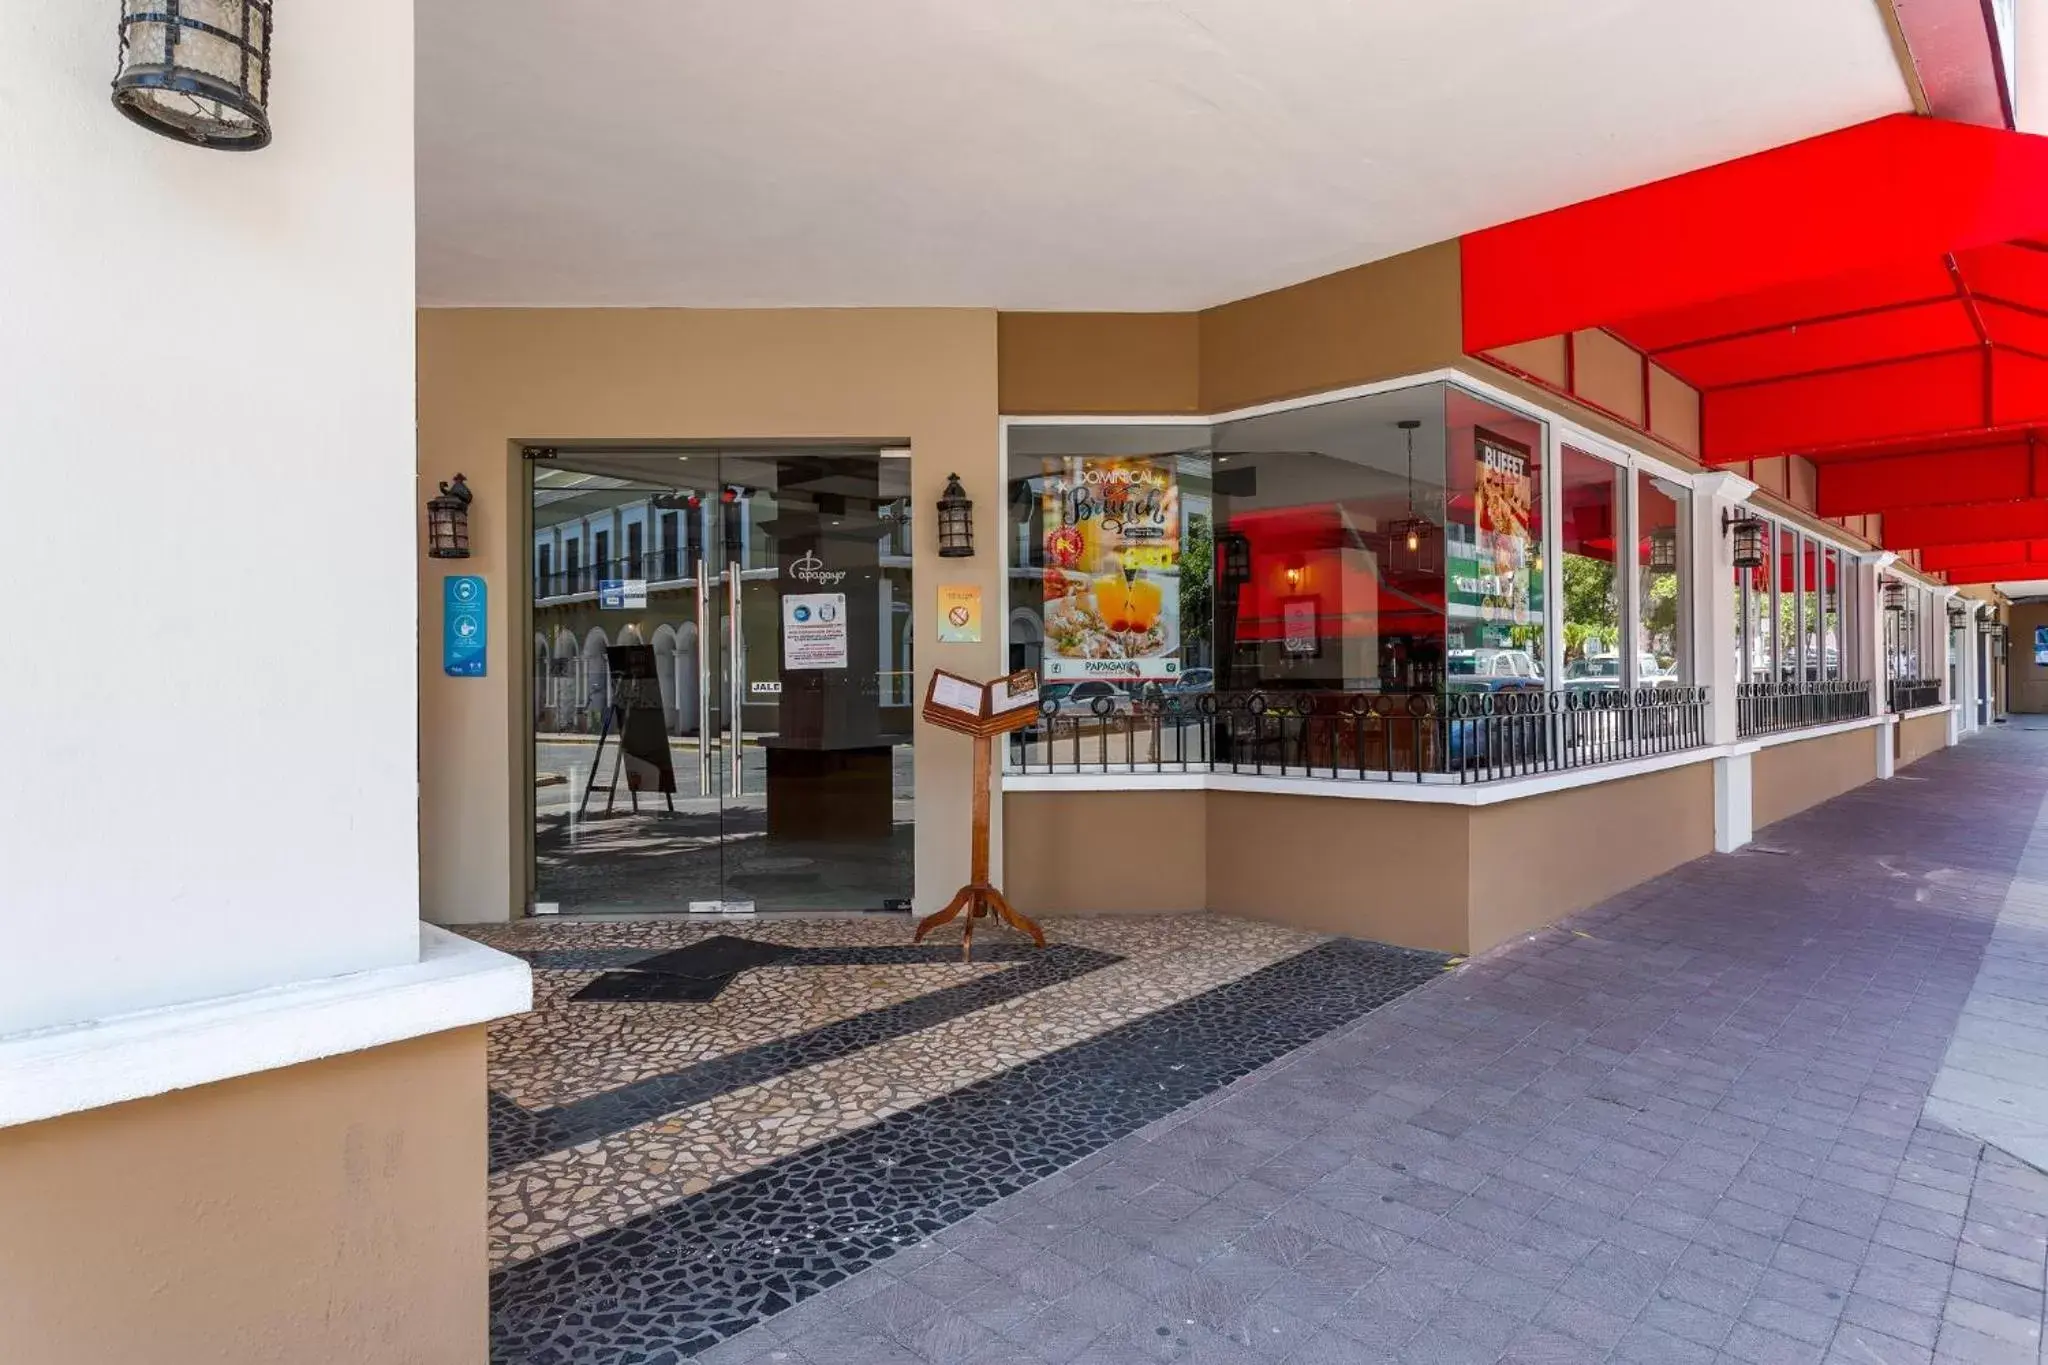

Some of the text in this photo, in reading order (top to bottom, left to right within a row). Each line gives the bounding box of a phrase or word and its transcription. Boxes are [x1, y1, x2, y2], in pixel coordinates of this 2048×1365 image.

[1080, 470, 1153, 484] DOMINICAL
[1484, 445, 1525, 478] BUFFET
[1063, 485, 1165, 529] Brunch
[789, 549, 846, 585] Papagayo
[752, 683, 781, 691] JALE
